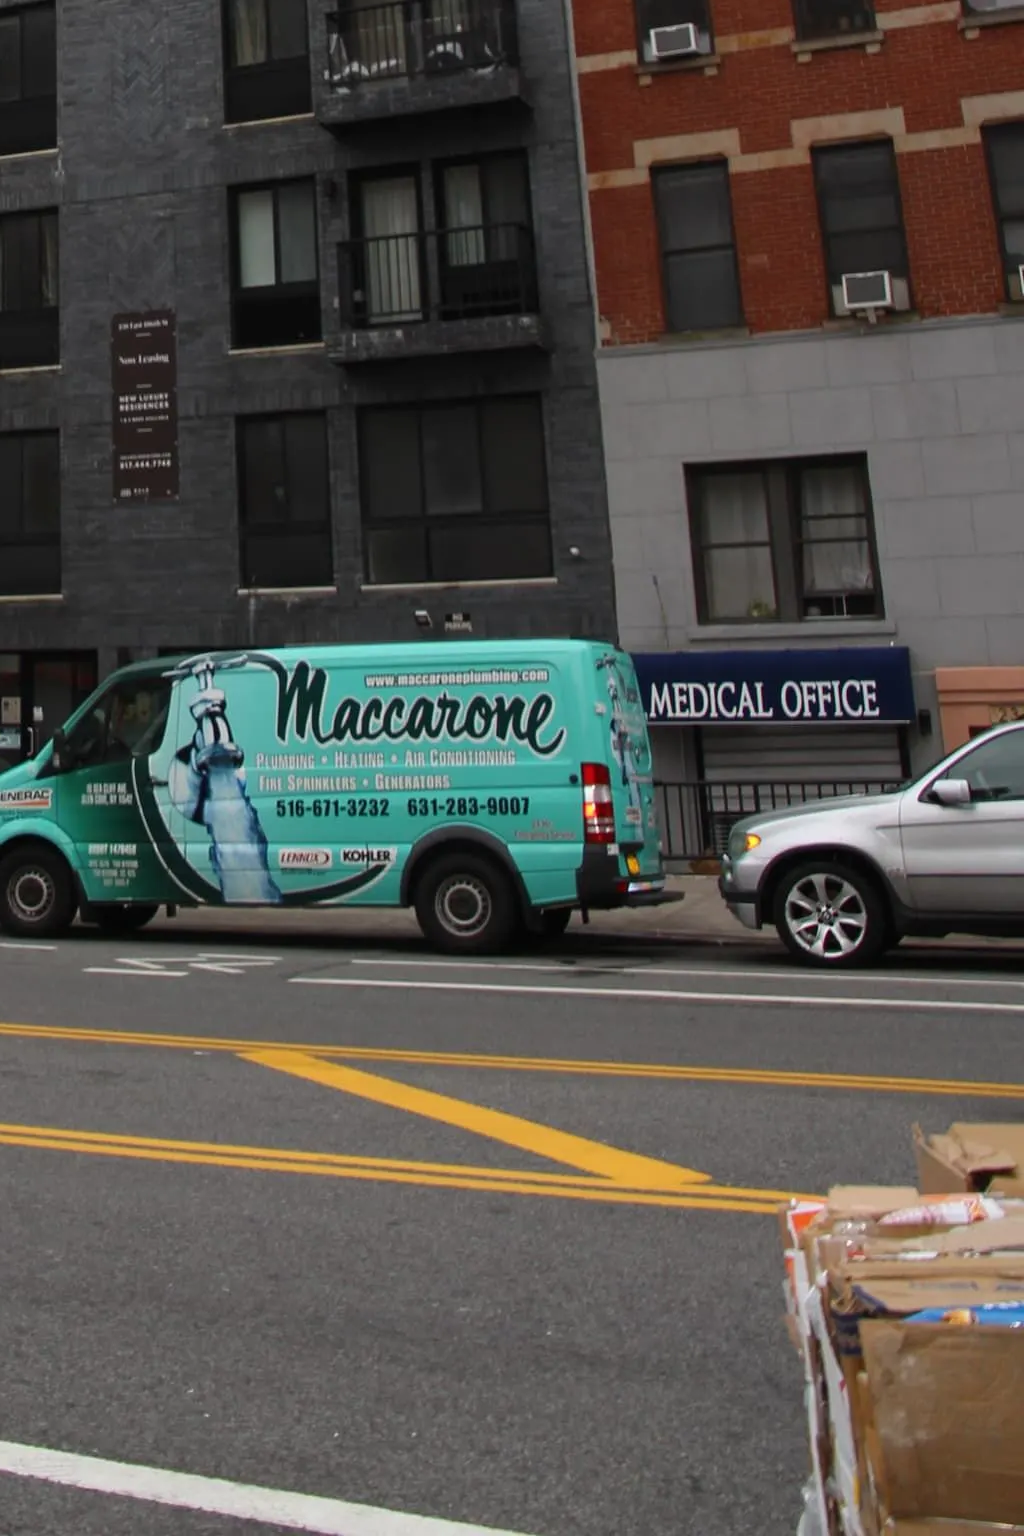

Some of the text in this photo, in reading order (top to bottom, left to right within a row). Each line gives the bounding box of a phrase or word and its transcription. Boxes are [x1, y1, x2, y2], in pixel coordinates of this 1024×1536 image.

[119, 392, 169, 403] NEW LUXURY
[119, 401, 169, 412] RESIDENCES
[365, 669, 549, 688] www.maccaroneplumbing.com
[275, 659, 565, 755] Maccarone
[650, 679, 880, 719] MEDICAL OFFICE
[256, 748, 516, 769] PLUMBING HEATING AIR CONDITIONING
[259, 773, 451, 792] FIRE SPRINKLERS GENERATORS
[276, 796, 530, 818] 516-671-3232 631-283-9007
[343, 850, 391, 863] KOHLER
